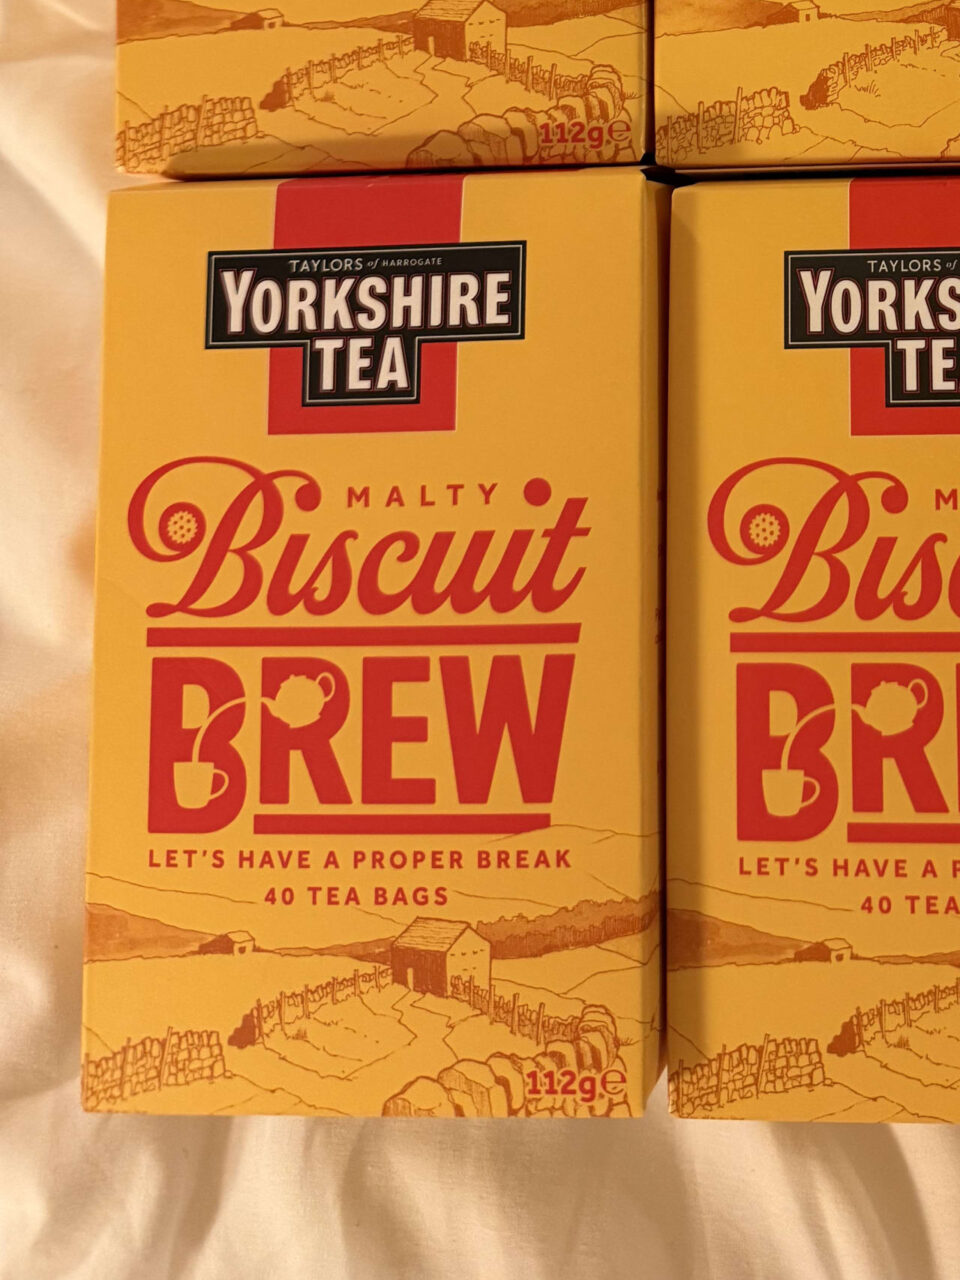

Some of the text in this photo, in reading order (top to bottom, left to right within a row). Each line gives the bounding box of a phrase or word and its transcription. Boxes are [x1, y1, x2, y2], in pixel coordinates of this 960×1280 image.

[289, 257, 363, 273] TAYLORS
[382, 257, 442, 267] HARROGATE
[867, 259, 941, 272] TAYLORS
[221, 269, 509, 334] YORKSHIRE
[313, 336, 409, 392] TEA
[346, 483, 498, 509] MALTY
[126, 456, 592, 619] Biscuit
[147, 653, 576, 837] BREW
[148, 848, 570, 871] LET'S HAVE A PROPER BREAK
[738, 856, 819, 877] LET'S
[832, 858, 907, 879] HAVE
[922, 859, 939, 879] A
[264, 886, 448, 907] 40 TEA BAGS
[860, 896, 892, 915] 40
[904, 894, 960, 916] TEA
